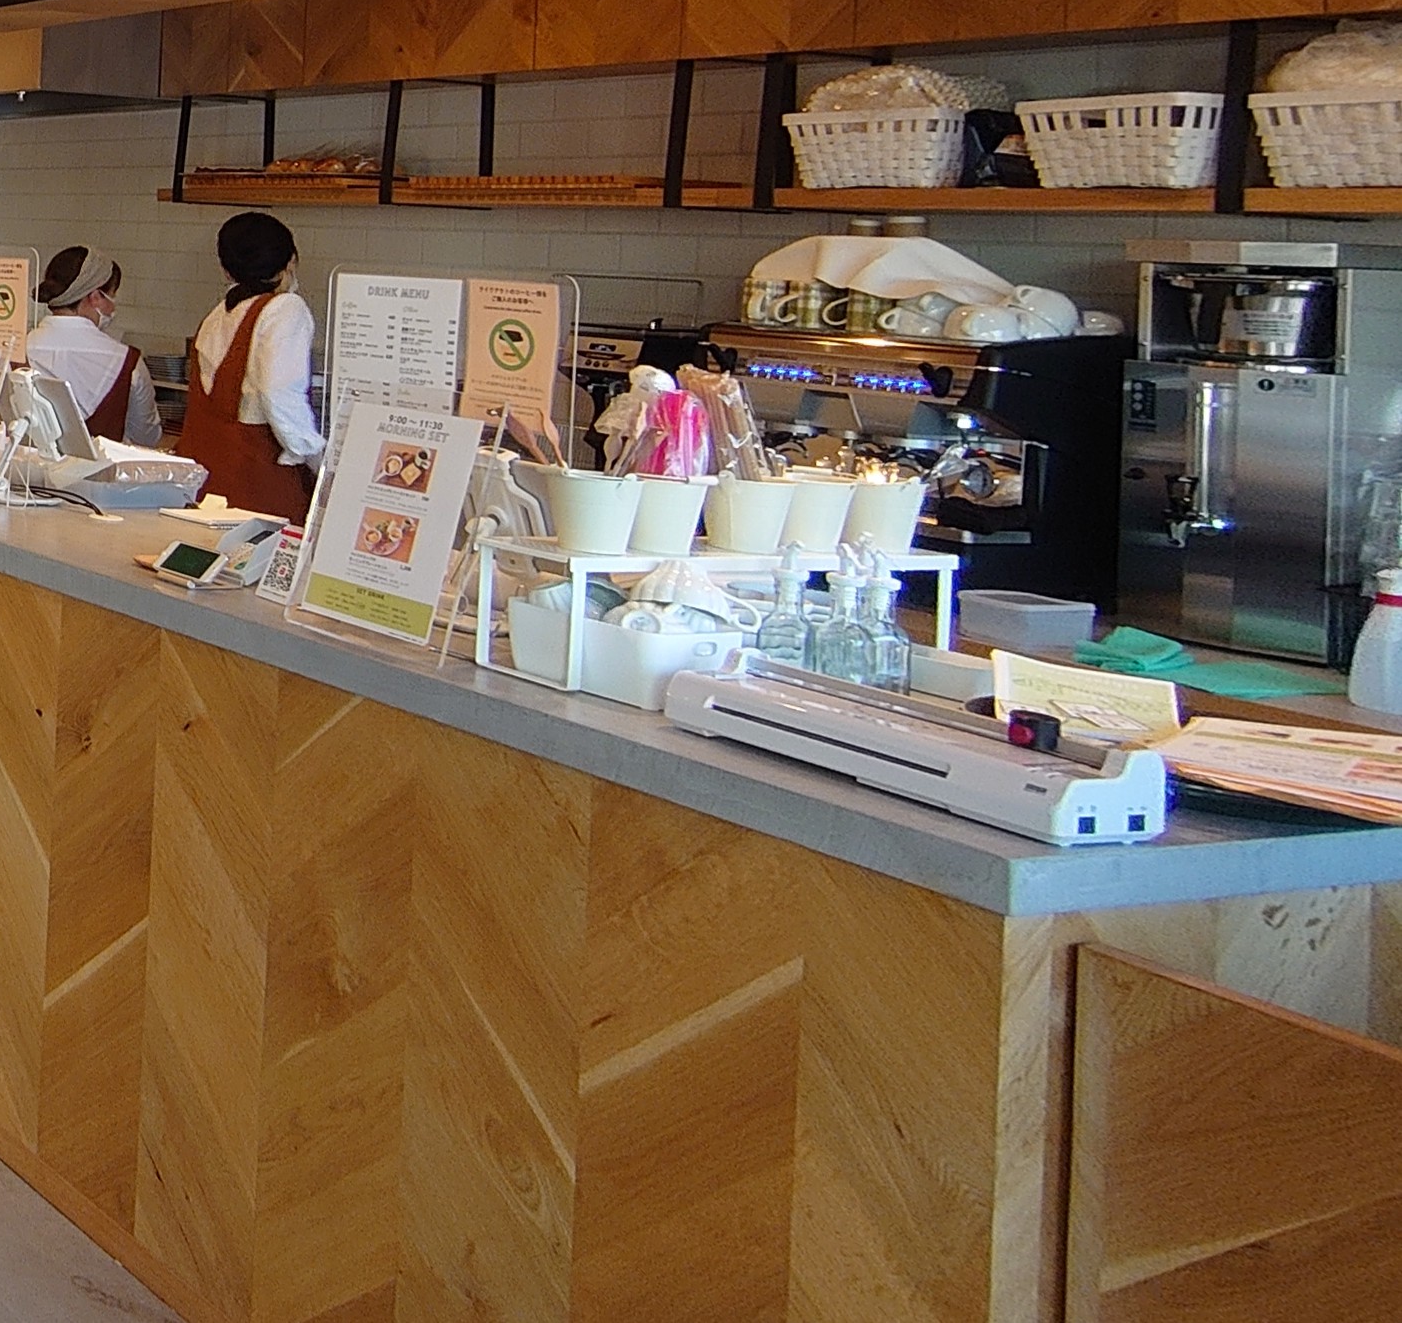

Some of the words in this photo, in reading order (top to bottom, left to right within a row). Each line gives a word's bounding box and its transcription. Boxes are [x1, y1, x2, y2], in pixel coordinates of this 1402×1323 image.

[388, 414, 408, 425] 9:00
[419, 420, 443, 430] 11:30
[377, 422, 426, 439] MORNING
[428, 431, 450, 443] SET
